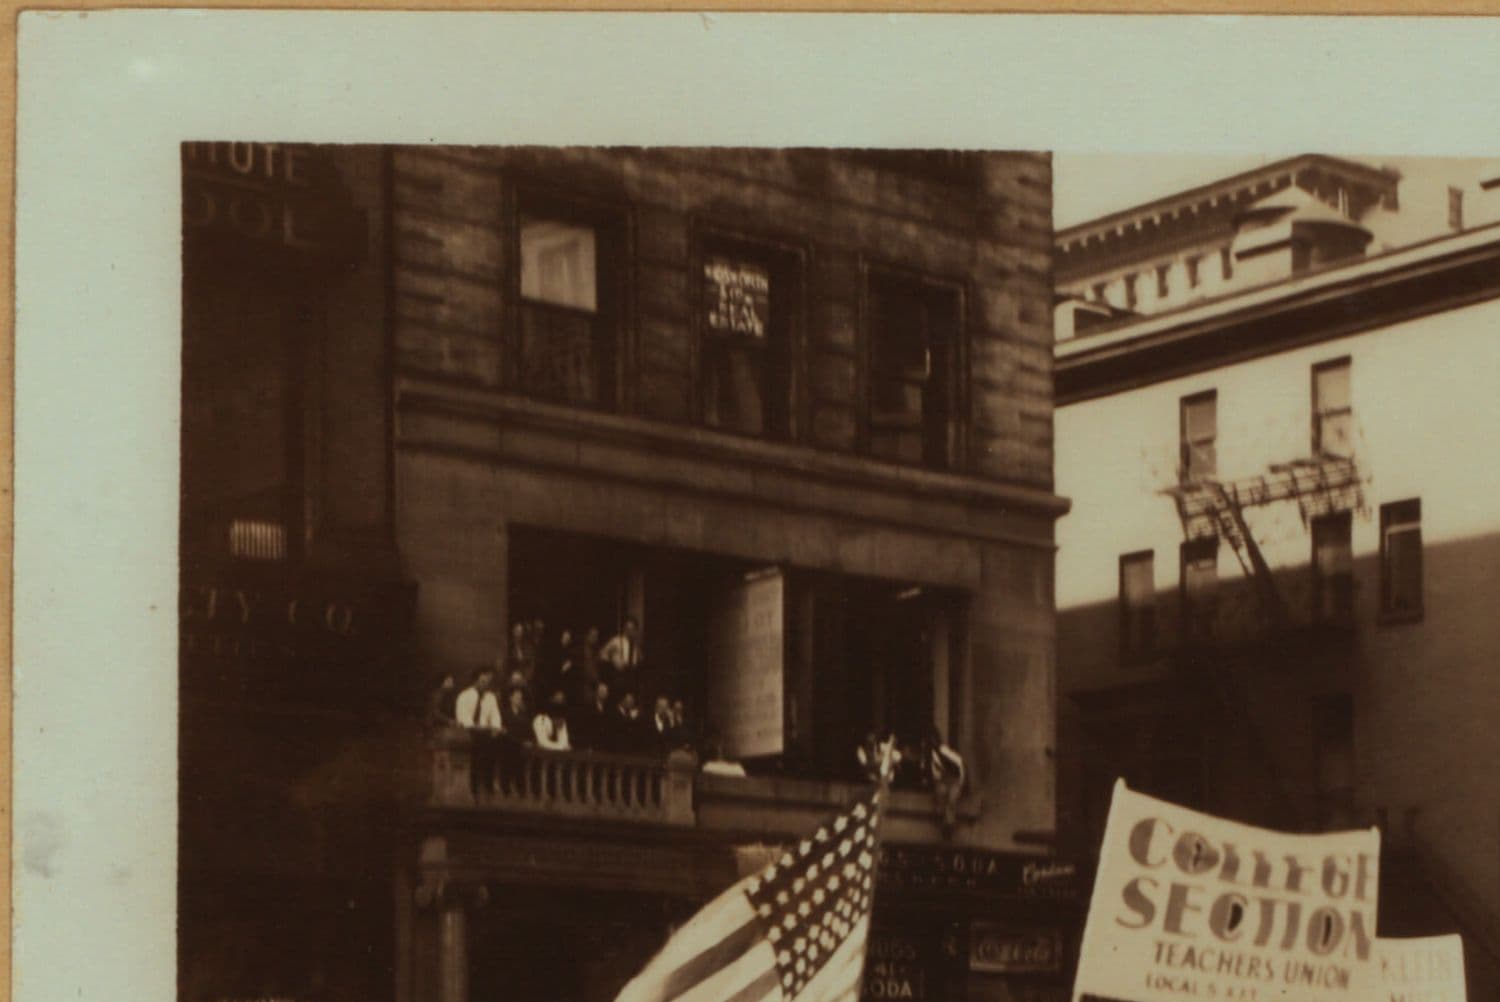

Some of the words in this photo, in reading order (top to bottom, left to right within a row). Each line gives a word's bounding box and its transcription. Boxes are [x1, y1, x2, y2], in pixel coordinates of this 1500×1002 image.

[1128, 817, 1372, 900] COLLEGE
[1114, 875, 1374, 962] SECTION
[1145, 970, 1198, 995] LOCAL
[1152, 940, 1275, 983] TEACHERS
[1282, 958, 1352, 992] UNION
